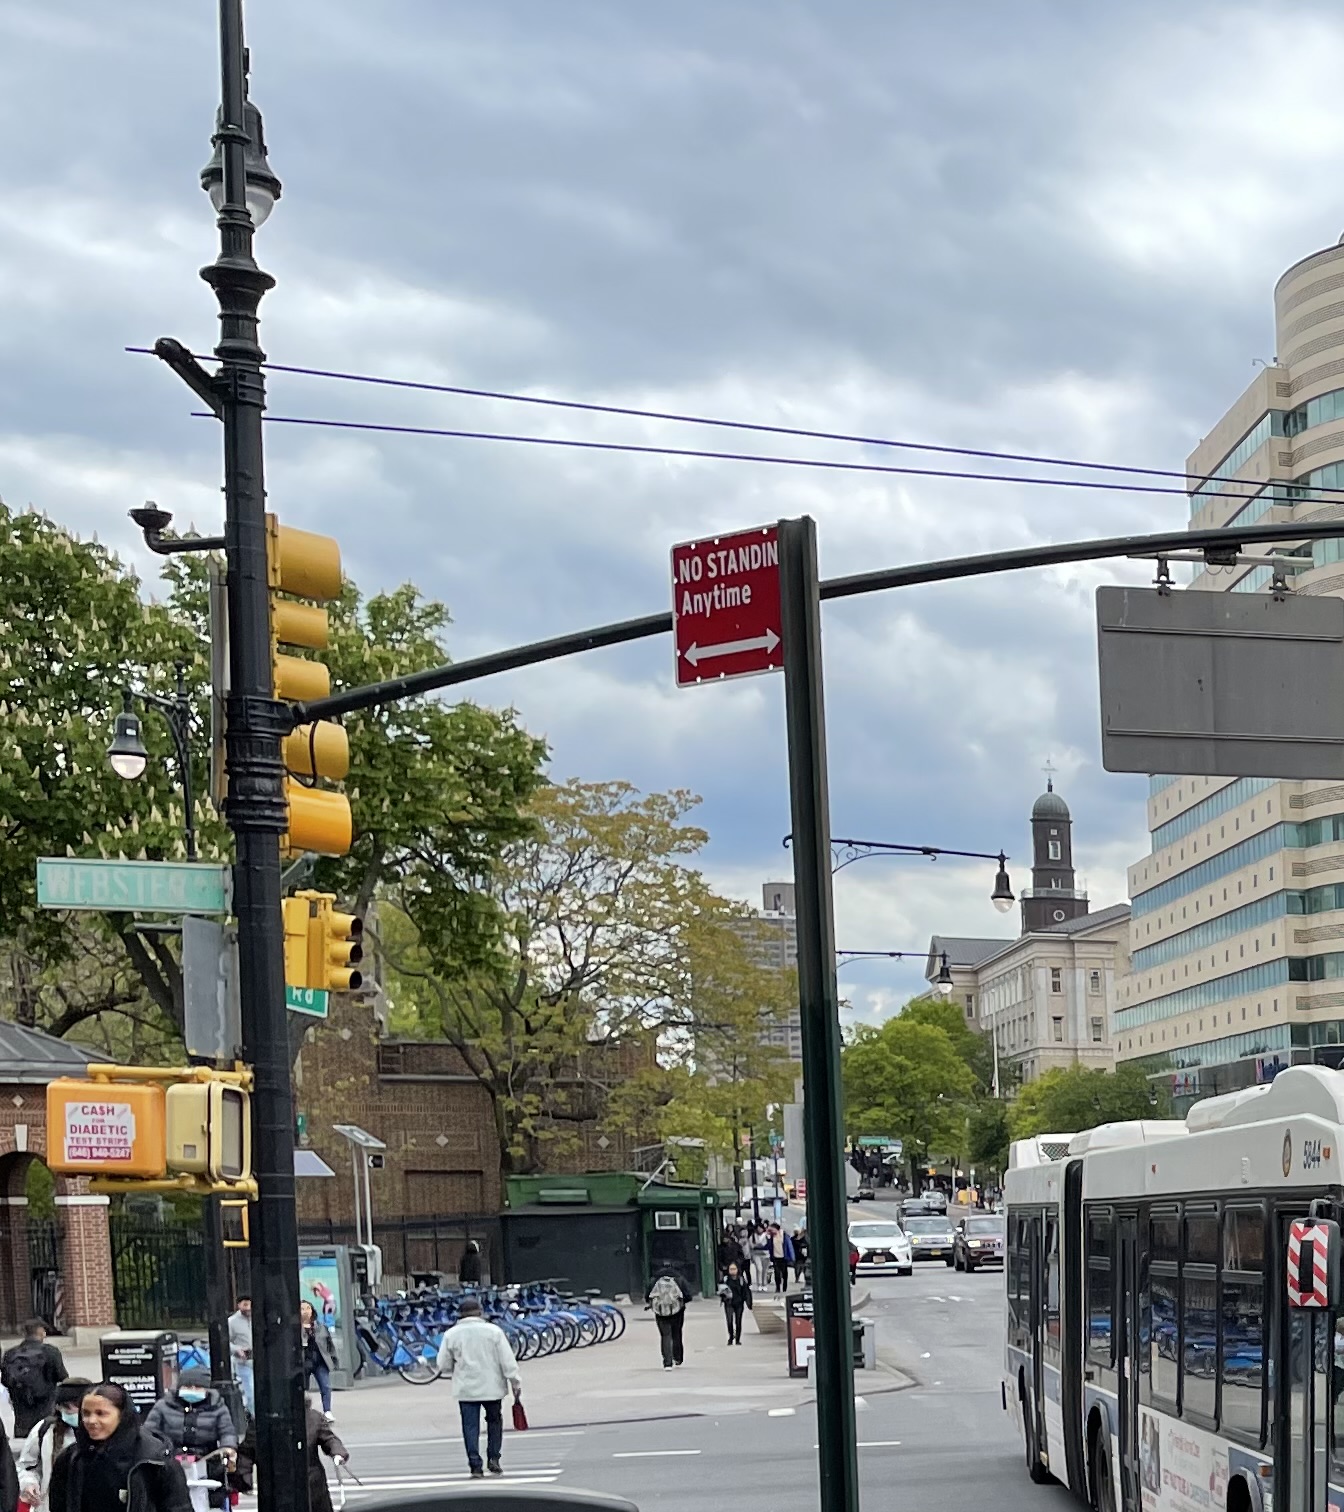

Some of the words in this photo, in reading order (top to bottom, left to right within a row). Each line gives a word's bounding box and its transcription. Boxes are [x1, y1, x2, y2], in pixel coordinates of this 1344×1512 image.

[679, 556, 702, 584] NO
[707, 541, 780, 579] STANDIN
[682, 583, 752, 618] Anytime
[48, 864, 187, 906] WEBSTER
[70, 1124, 128, 1135] DIABETIC
[96, 1137, 128, 1145] STRIPS
